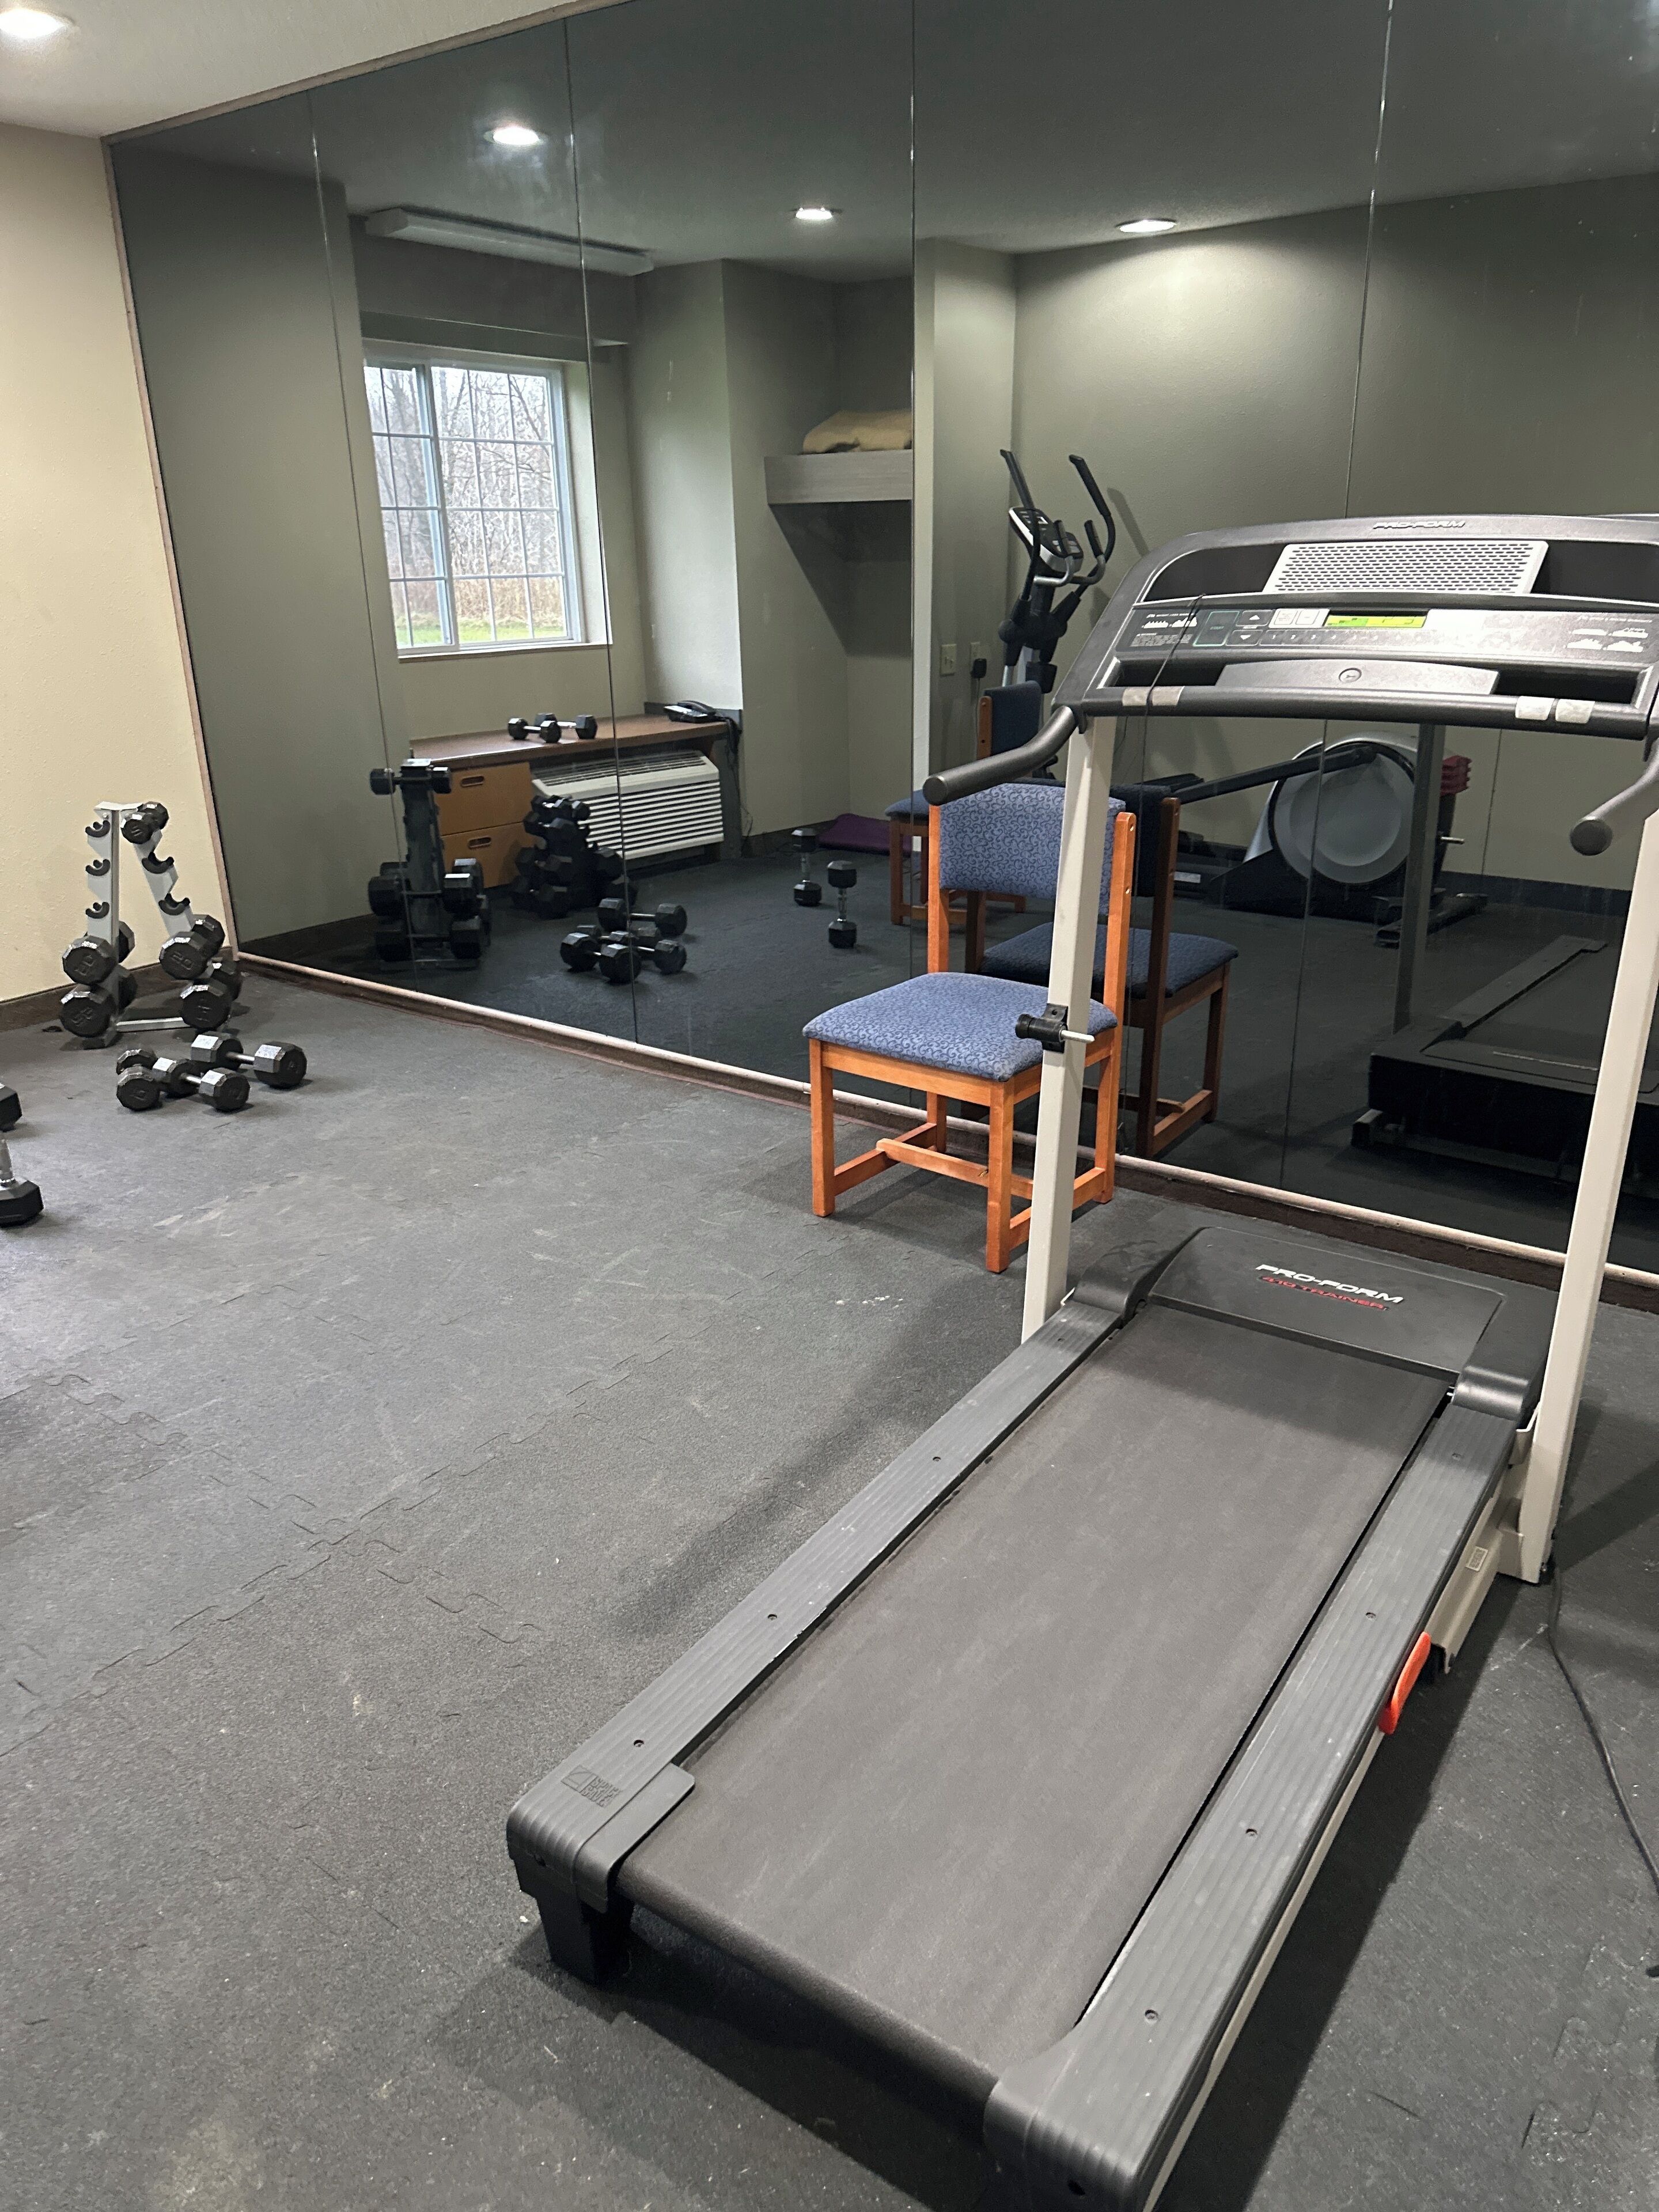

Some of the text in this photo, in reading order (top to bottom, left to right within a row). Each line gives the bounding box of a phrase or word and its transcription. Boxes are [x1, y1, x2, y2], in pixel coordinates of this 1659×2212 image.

[1373, 521, 1465, 529] PRO-FORM
[1255, 1264, 1404, 1304] PRO-FORM
[1300, 1285, 1385, 1310] TRAINER
